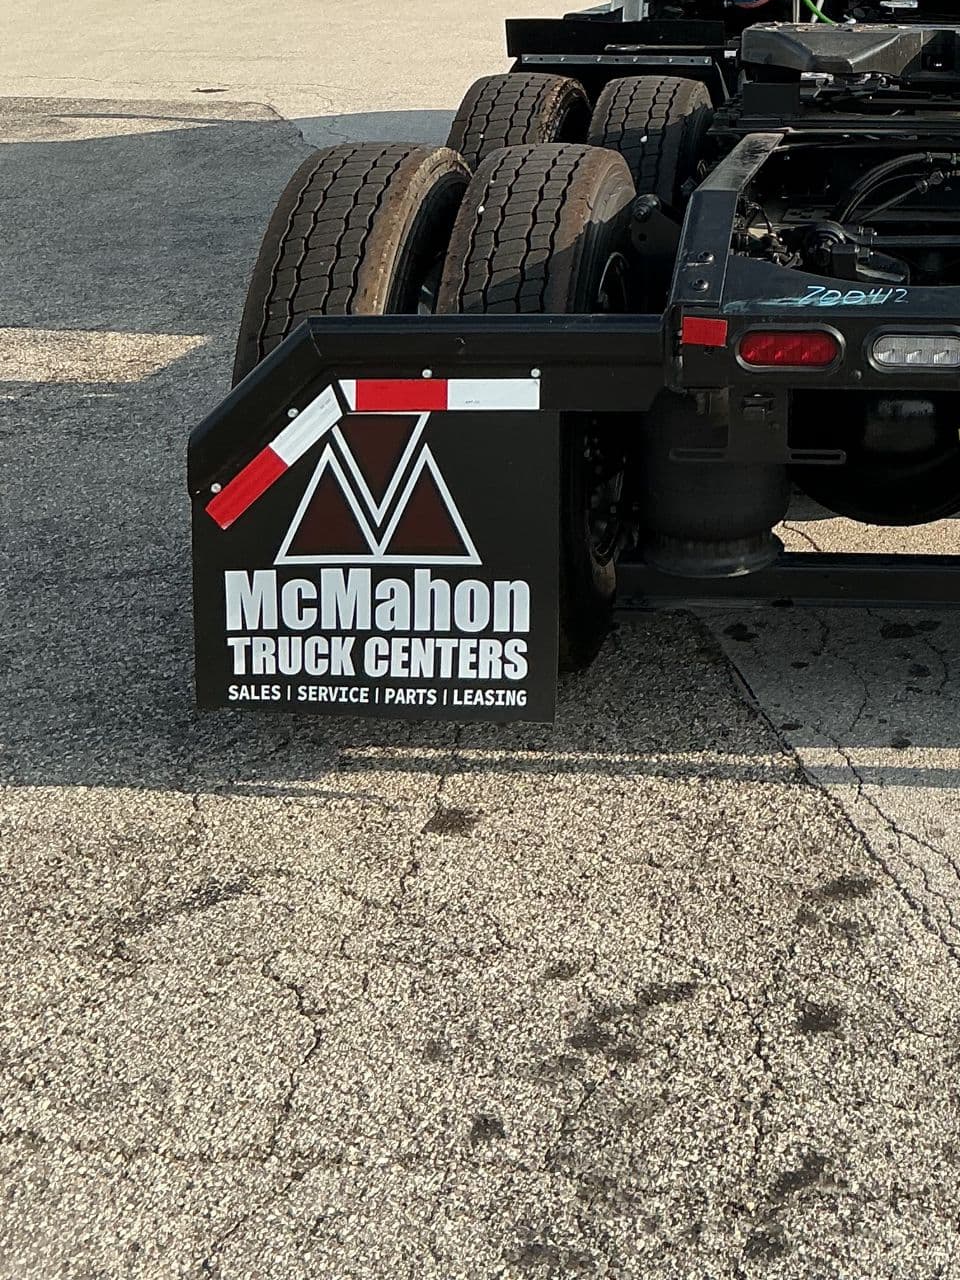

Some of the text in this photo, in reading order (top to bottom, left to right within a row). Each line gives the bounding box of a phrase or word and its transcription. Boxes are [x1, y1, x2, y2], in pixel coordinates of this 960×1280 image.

[225, 568, 531, 632] McMahon
[227, 636, 528, 680] TRUCK CENTERS
[228, 684, 527, 707] SALES SERVICE PARTS LEASING
